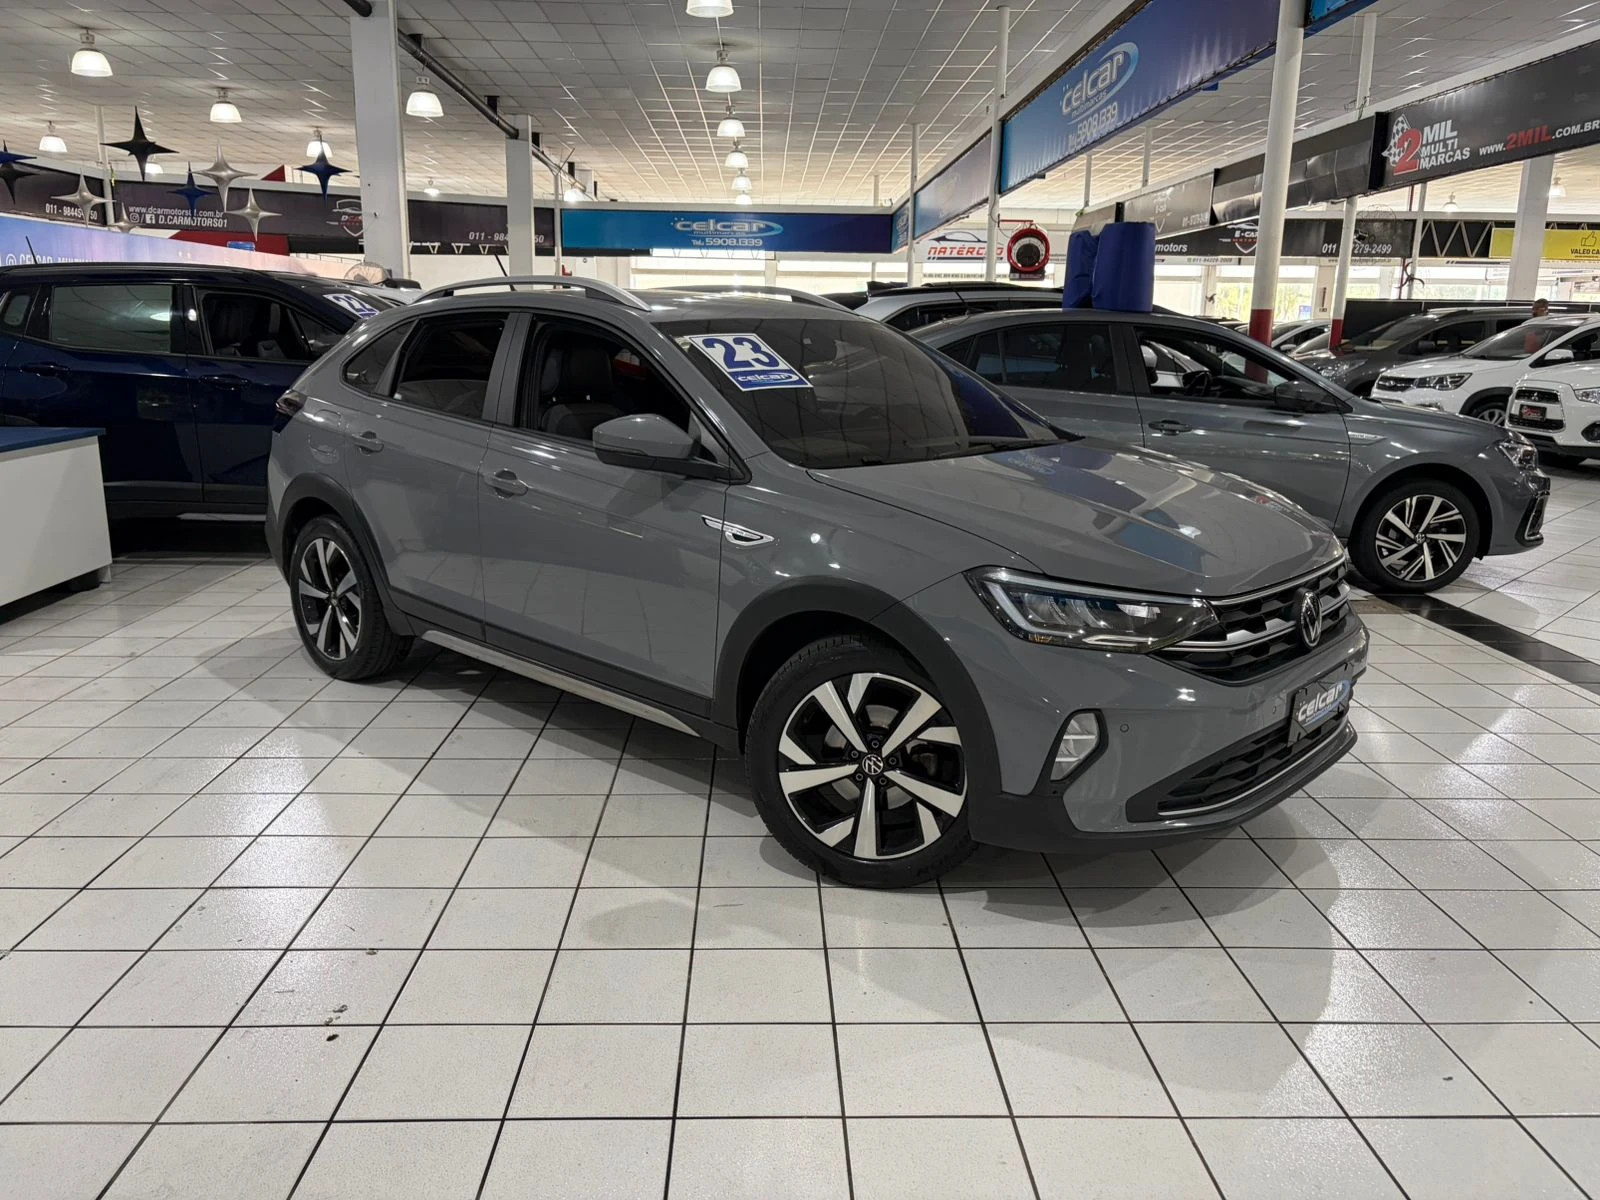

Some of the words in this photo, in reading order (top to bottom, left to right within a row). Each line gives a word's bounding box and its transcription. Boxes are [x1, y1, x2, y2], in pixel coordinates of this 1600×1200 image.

[1062, 51, 1125, 115] celcar
[1394, 128, 1423, 175] 2
[1423, 119, 1458, 144] MIL
[1421, 138, 1458, 156] MULTI
[1479, 118, 1600, 156] www.2MIL.COM.BR
[1420, 147, 1471, 170] MARCAS
[45, 203, 57, 214] 011
[128, 206, 223, 218] www.dcarmotors1.com.br
[674, 218, 766, 232] celcar
[469, 231, 485, 240] 011
[1322, 243, 1337, 253] 011
[702, 337, 780, 369] 23
[1297, 682, 1343, 721] celcar
